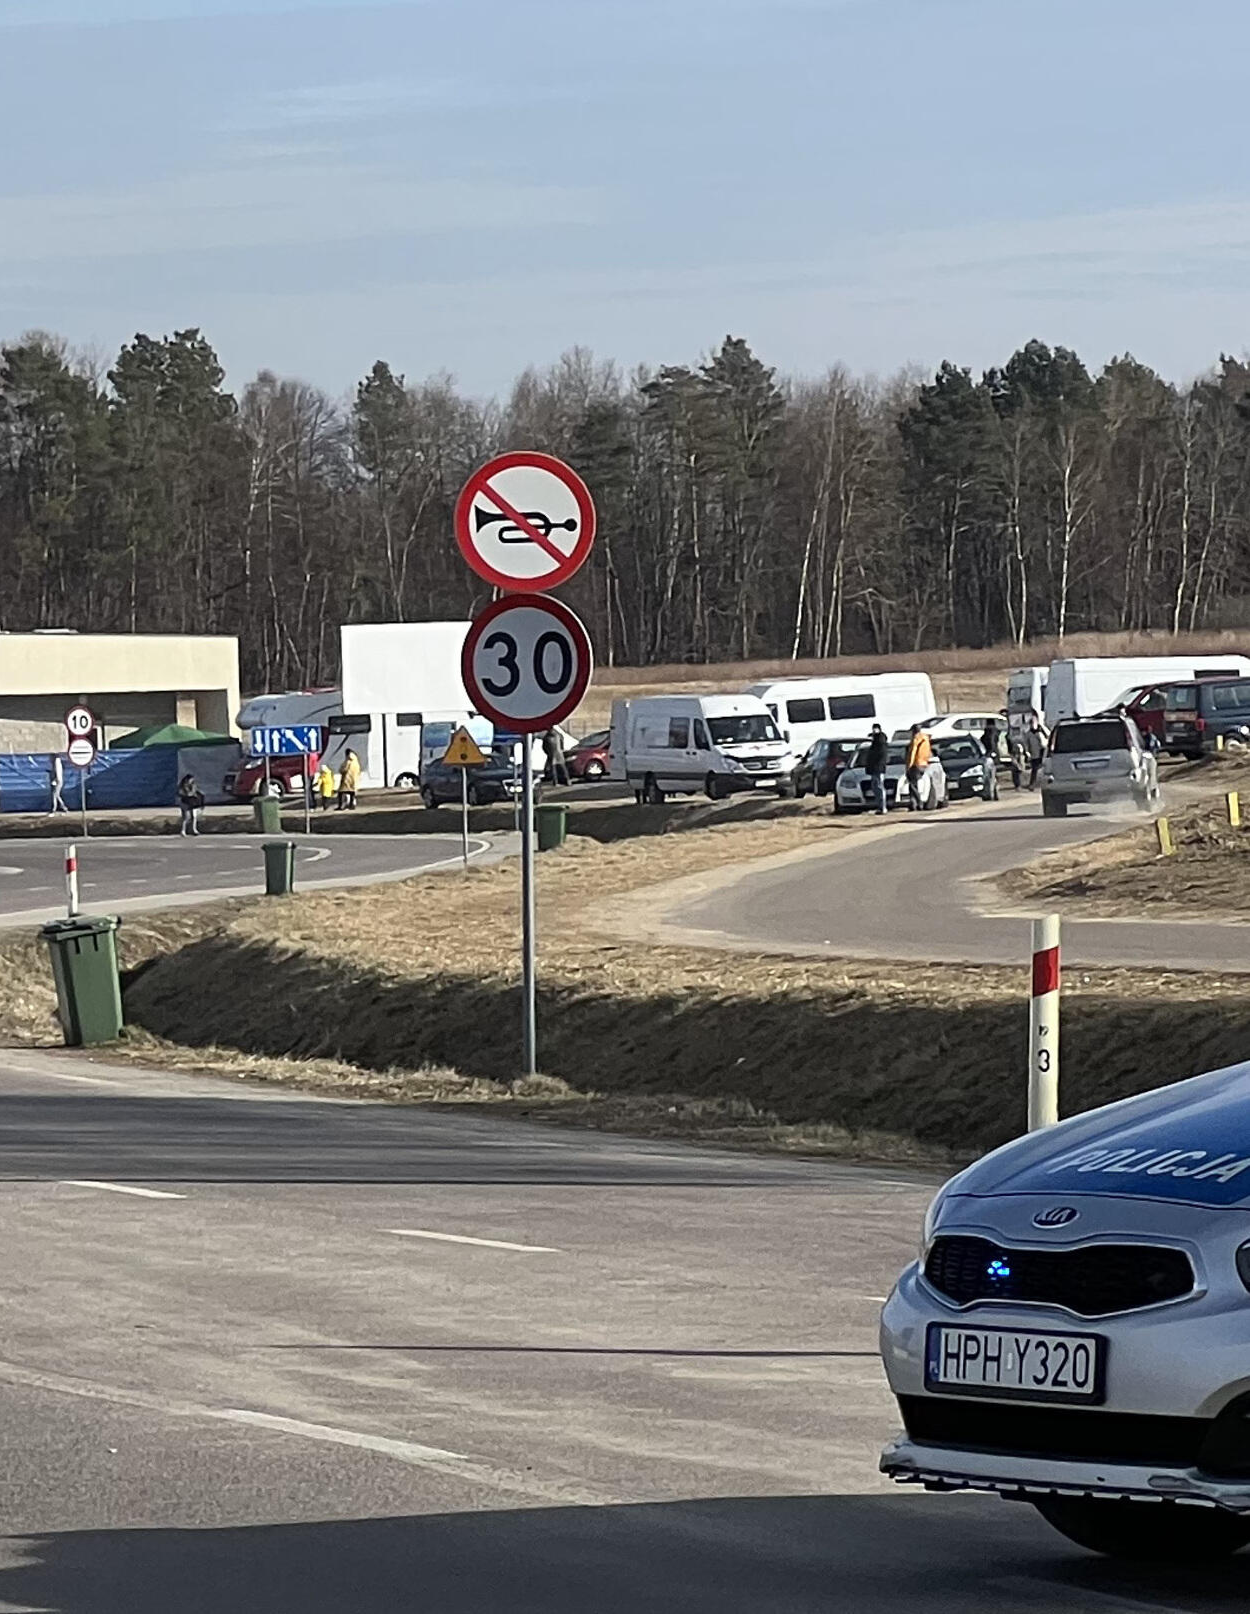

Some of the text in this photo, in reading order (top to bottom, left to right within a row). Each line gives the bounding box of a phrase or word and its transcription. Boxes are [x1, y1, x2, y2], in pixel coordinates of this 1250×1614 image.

[481, 631, 572, 697] 30
[72, 715, 88, 729] 10
[1038, 1049, 1050, 1072] 3
[1047, 1148, 1250, 1183] POLICJA
[1036, 1207, 1072, 1222] KIA
[943, 1333, 1090, 1388] HPH Y320
